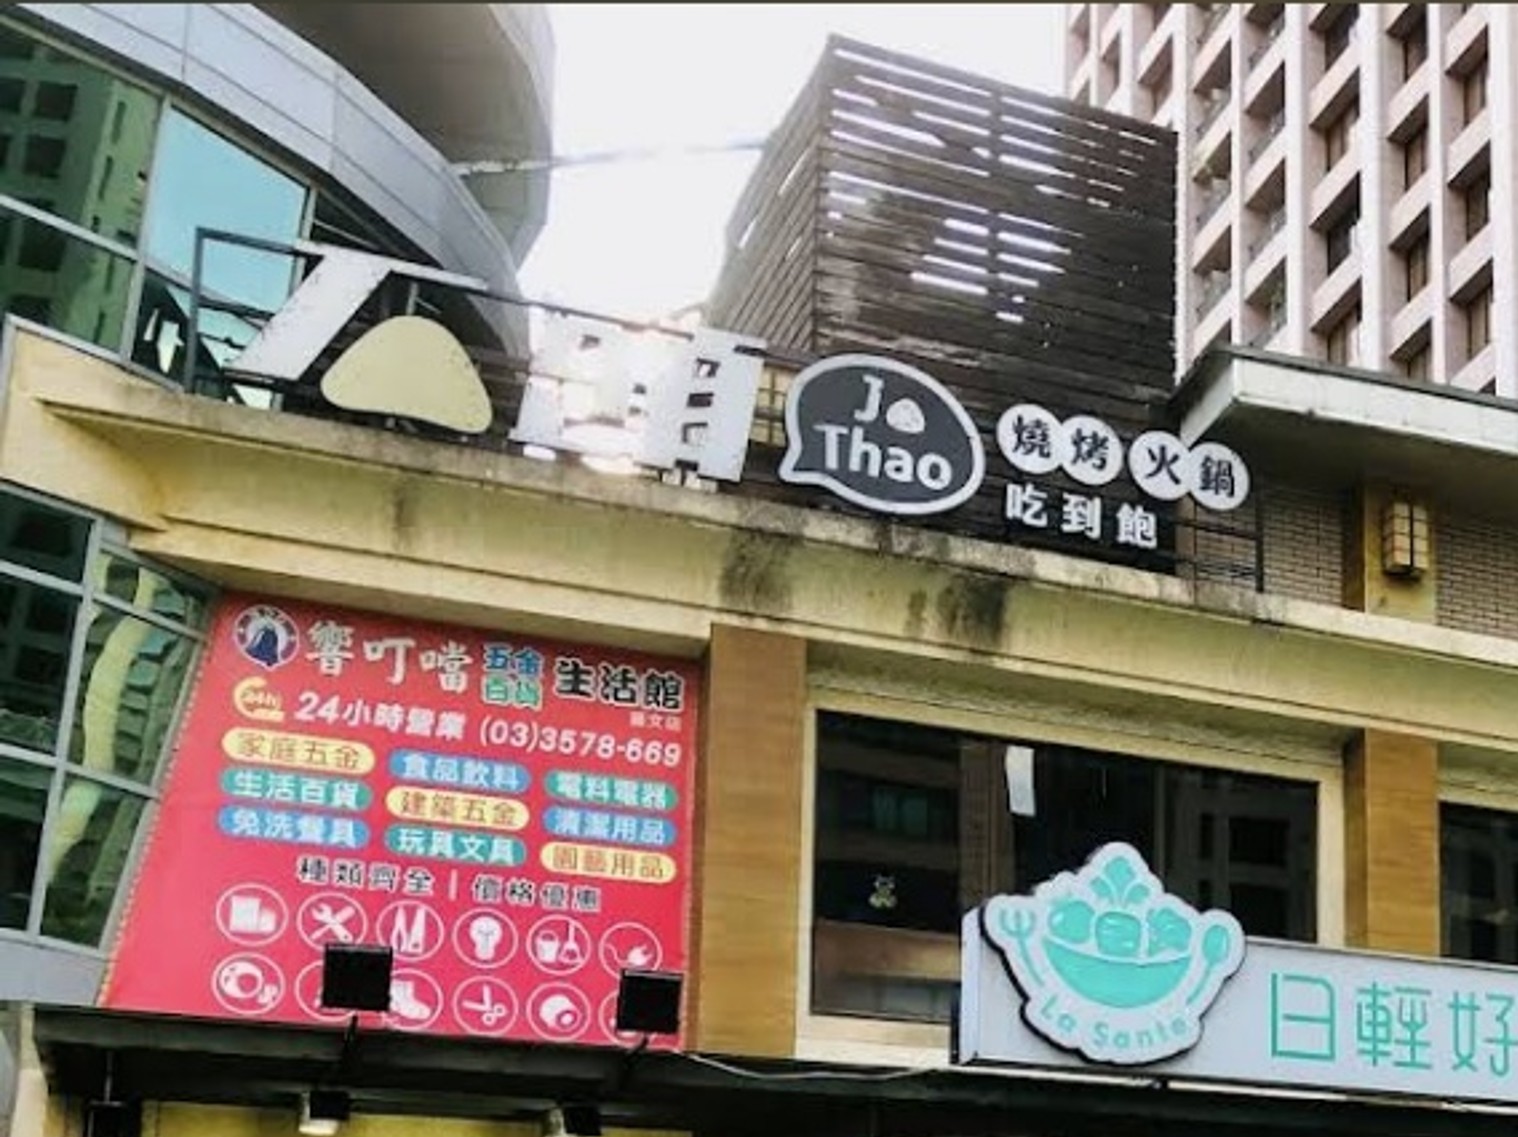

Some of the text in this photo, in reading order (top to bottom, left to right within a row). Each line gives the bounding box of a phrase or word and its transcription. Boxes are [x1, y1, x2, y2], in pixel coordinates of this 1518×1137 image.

[813, 423, 953, 491] Thao
[1011, 414, 1237, 499] 燒烤火鍋
[1004, 483, 1159, 549] 吃到飽
[305, 619, 472, 694] 響叮噹
[483, 641, 545, 677] 五金
[480, 674, 543, 712] 百貨
[553, 655, 686, 713] 生活館
[293, 690, 682, 768] 24小時營業 (03)3578-669
[237, 731, 359, 770] 家庭五金
[233, 770, 359, 811] 生活百貨
[402, 752, 519, 791] 食品飲料
[400, 790, 517, 827] 建築五金
[397, 827, 514, 865] 玩具文具
[552, 845, 664, 879] 園藝用品
[296, 855, 601, 913] 種類齊全 價格優惠
[1040, 995, 1077, 1032] La
